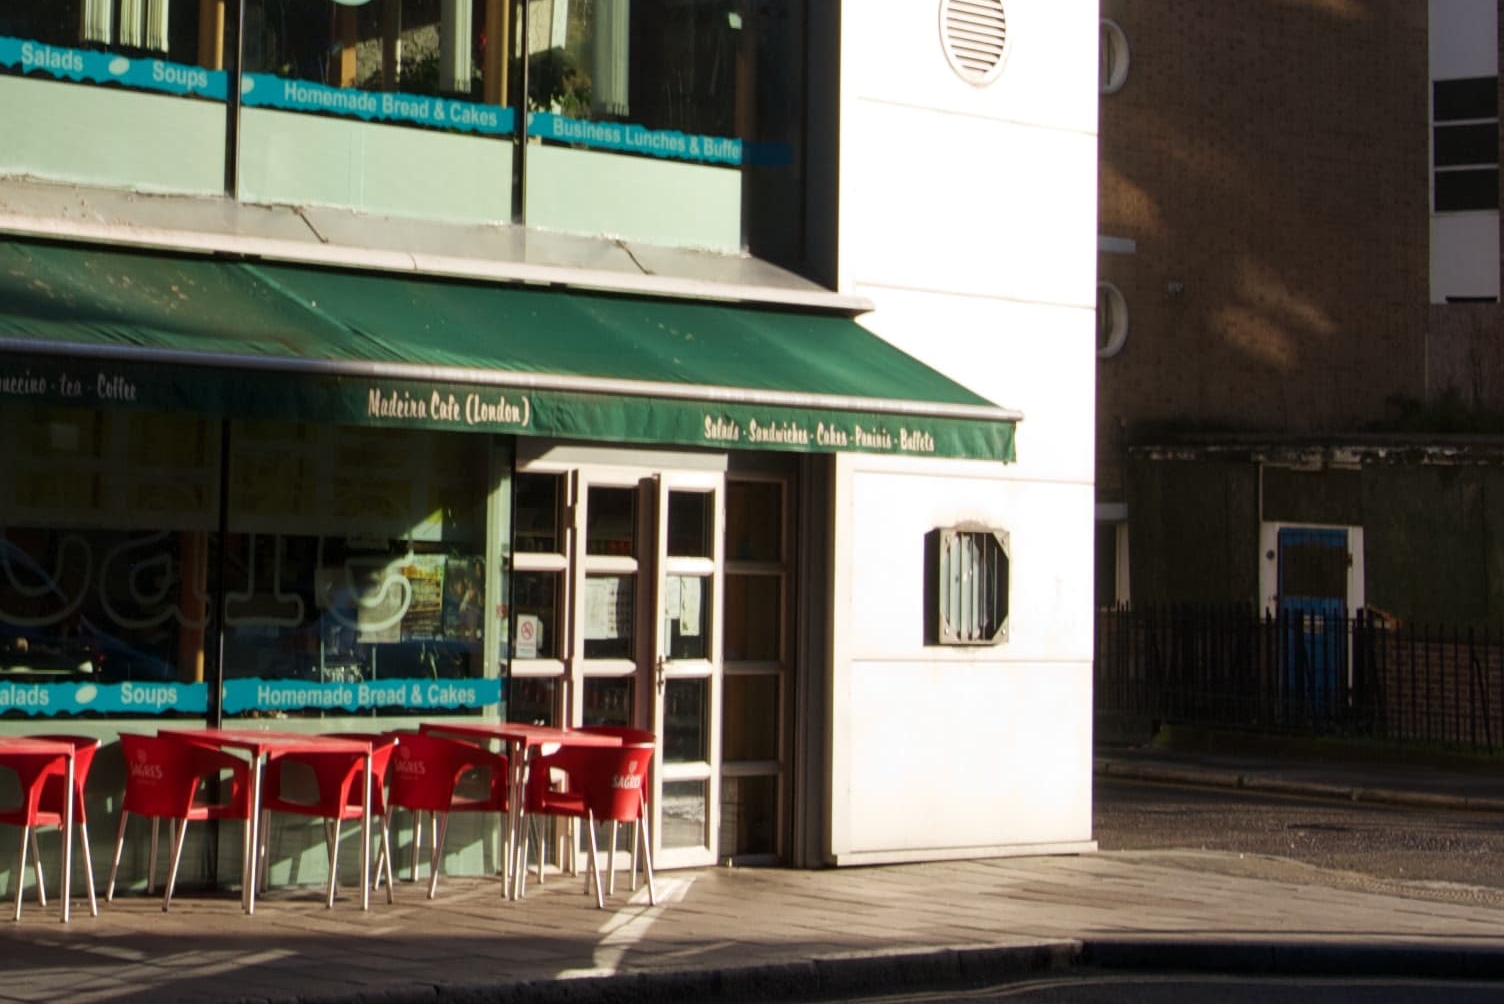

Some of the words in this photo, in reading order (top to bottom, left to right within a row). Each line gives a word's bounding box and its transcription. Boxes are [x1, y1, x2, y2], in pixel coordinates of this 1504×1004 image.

[20, 43, 84, 71] Salads
[152, 61, 209, 89] Soups
[283, 81, 377, 113] Homemade
[381, 91, 429, 121] Bread
[433, 100, 447, 120] &
[449, 101, 499, 128] Cakes
[552, 117, 621, 145] Business
[625, 126, 686, 153] Lunches
[689, 137, 700, 155] &
[97, 372, 137, 402] Coffee
[368, 387, 427, 419] Madeira
[430, 390, 461, 421] Cafe
[465, 393, 531, 427] (London)
[704, 414, 740, 442] Salads
[749, 417, 809, 445] Sandwiches
[816, 421, 847, 447] Cakes
[900, 427, 935, 452] Buffets
[120, 681, 178, 710] Soups
[257, 684, 353, 707] Homemade
[357, 684, 406, 705] Bread
[410, 684, 423, 705] &
[427, 683, 476, 706] Cakes
